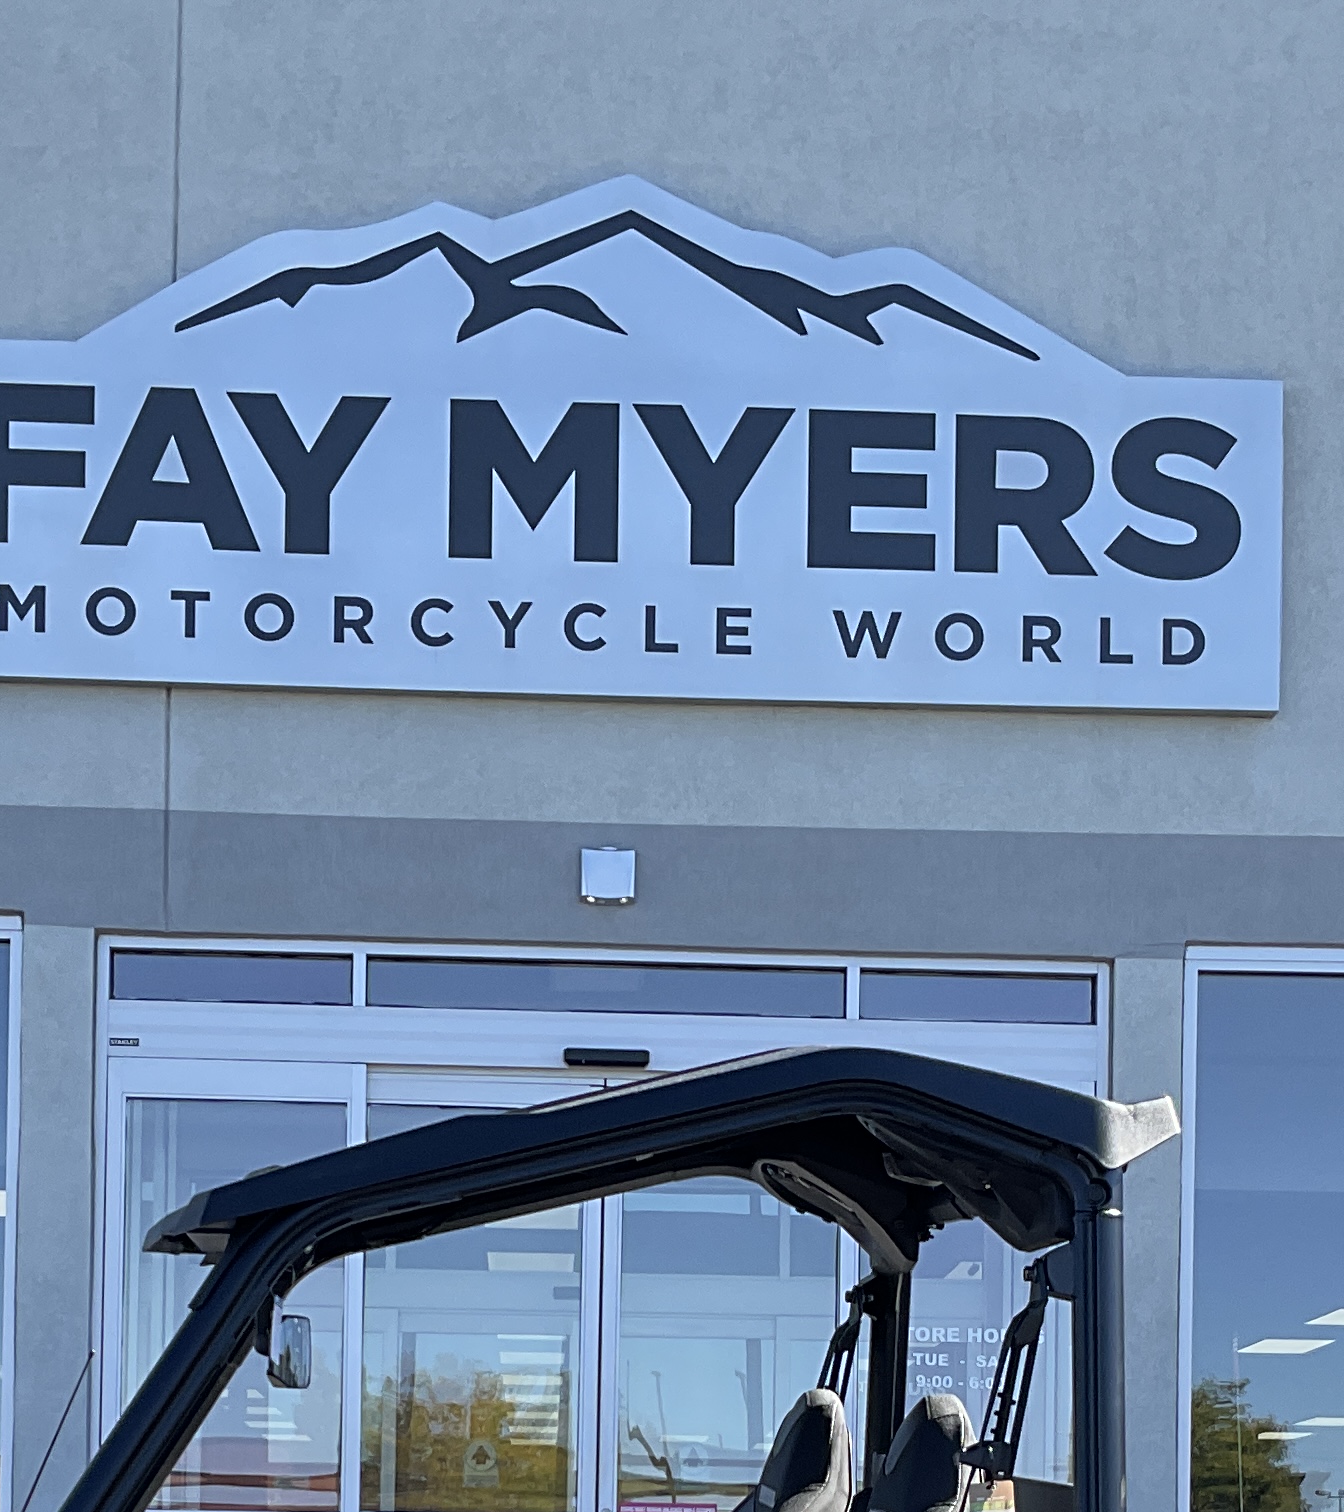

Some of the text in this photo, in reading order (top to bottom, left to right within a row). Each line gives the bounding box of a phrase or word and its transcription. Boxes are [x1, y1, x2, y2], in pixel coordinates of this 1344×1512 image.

[448, 398, 1242, 581] MYERS
[832, 609, 1206, 666] WORLD
[912, 1352, 949, 1367] TUE
[975, 1355, 998, 1368] SA
[915, 1374, 953, 1389] 9:00
[969, 1376, 996, 1390] 6:0
